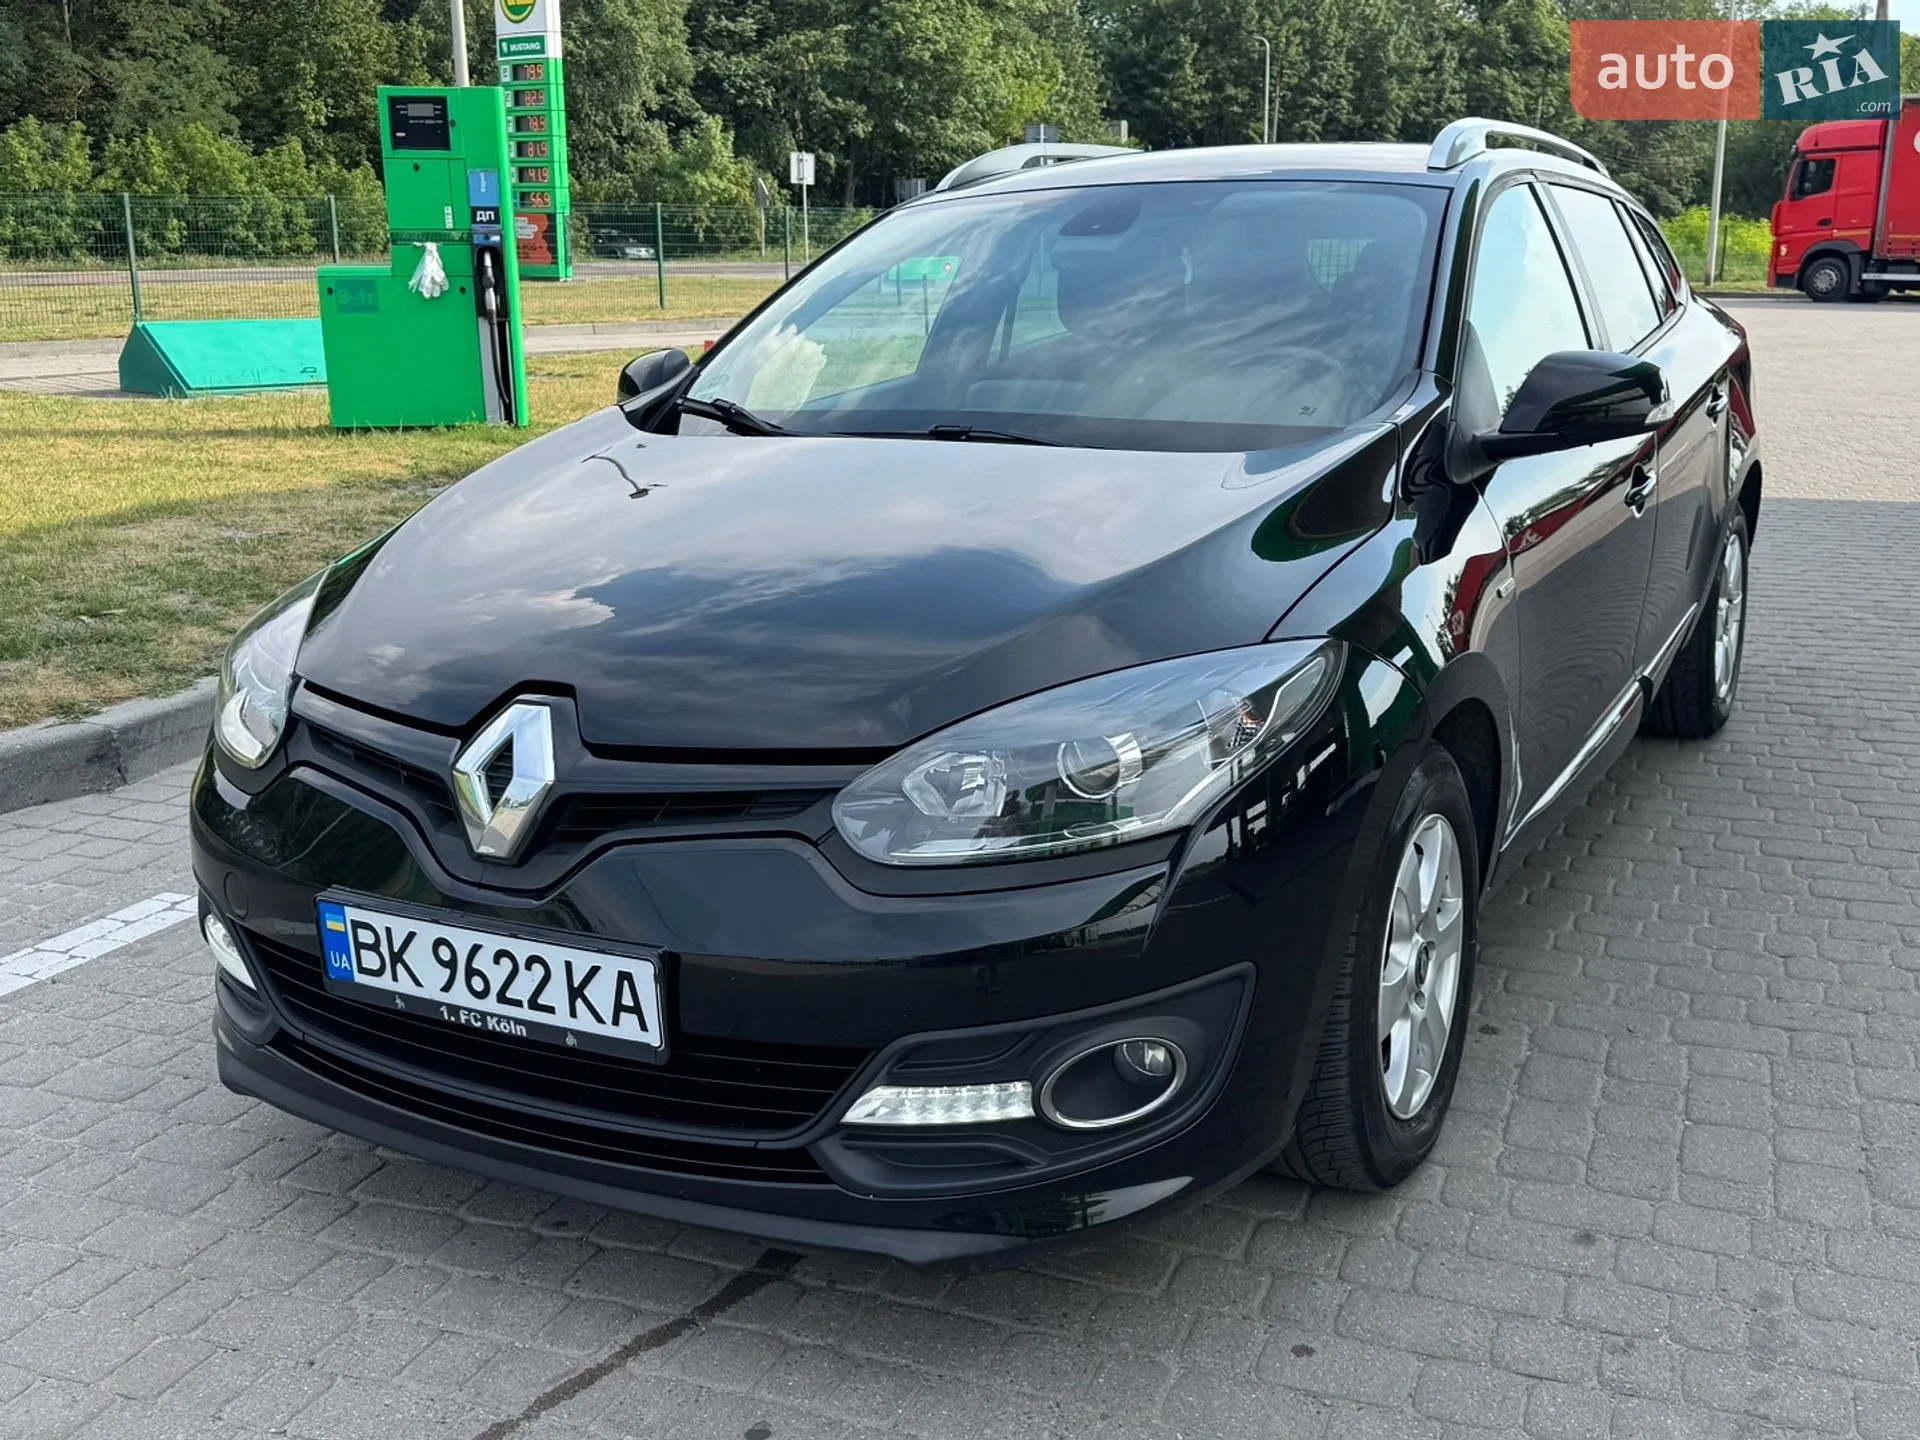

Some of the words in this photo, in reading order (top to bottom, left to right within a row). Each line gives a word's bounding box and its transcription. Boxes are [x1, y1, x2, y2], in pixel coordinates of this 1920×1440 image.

[510, 42, 541, 52] MUSTANG
[330, 950, 351, 971] UA
[350, 918, 425, 988] BK
[431, 936, 557, 1015] 9622
[564, 959, 649, 1034] KA
[440, 1005, 455, 1022] 1.
[459, 1010, 482, 1027] FC
[486, 1015, 527, 1037] Köln
